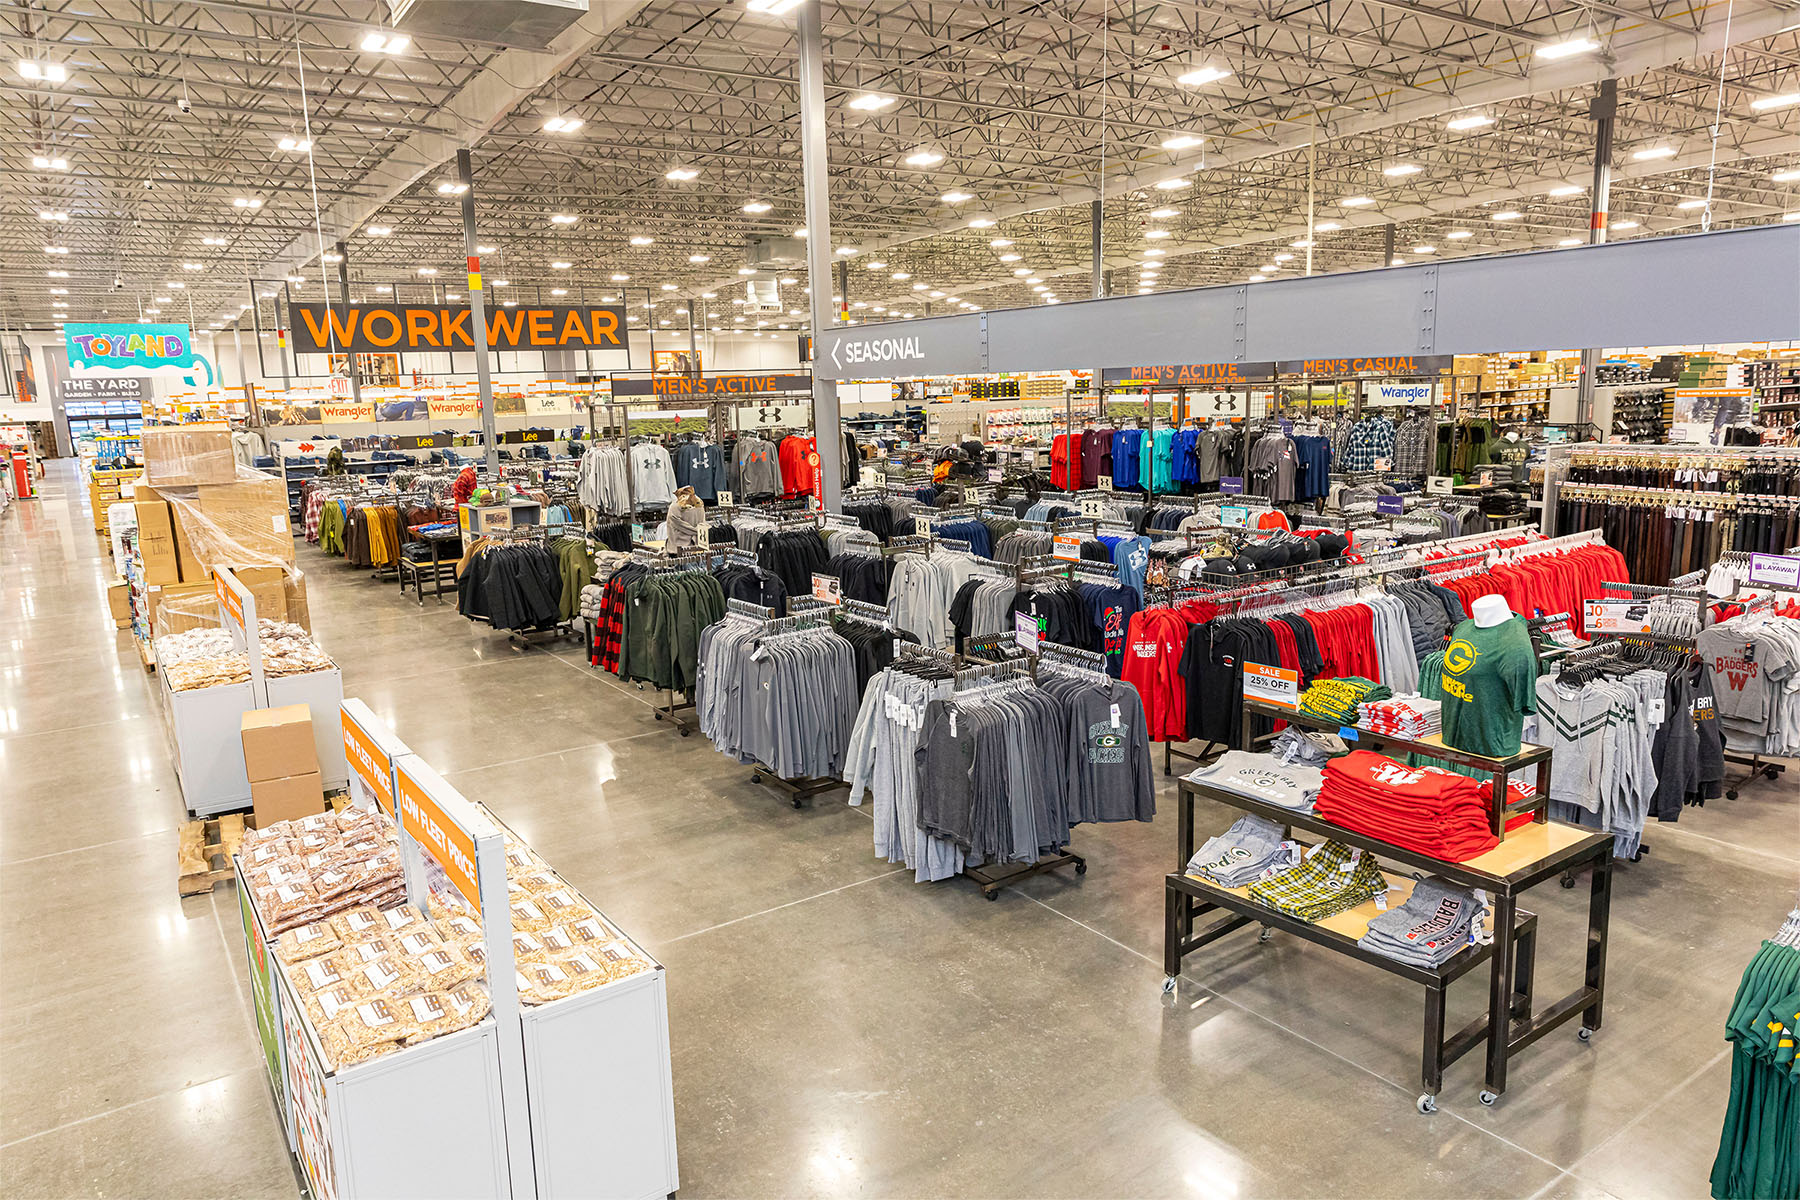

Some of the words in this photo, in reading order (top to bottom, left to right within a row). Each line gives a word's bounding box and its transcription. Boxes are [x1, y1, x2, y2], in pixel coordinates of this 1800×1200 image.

[300, 308, 621, 348] WORKWEAR
[72, 334, 183, 358] TOYLAND
[845, 337, 925, 363] SEASONAL
[1131, 365, 1175, 379] MEN'S
[1179, 363, 1238, 378] ACTIVE
[1303, 359, 1349, 373] MEN'S
[1352, 356, 1418, 371] CASUAL
[62, 380, 93, 391] THE
[96, 379, 140, 390] YARD
[332, 379, 349, 394] EXIT
[652, 379, 708, 394] MEN'S
[713, 377, 776, 393] ACTIVE
[1380, 386, 1430, 403] Wrangler
[431, 403, 475, 416] Wrangler
[541, 399, 555, 407] Lee
[323, 405, 372, 420] Wrangler
[416, 437, 434, 447] Lee
[522, 432, 538, 442] Lee
[1763, 564, 1797, 573] LAYAWAY
[1259, 666, 1281, 677] SALE
[1716, 657, 1758, 679] BADGERS
[1250, 675, 1269, 687] 25%
[1270, 680, 1290, 690] OFF
[1727, 671, 1749, 691] W
[1697, 696, 1713, 709] BAY
[343, 727, 355, 752] LOW
[355, 741, 373, 772] FLEET
[373, 760, 392, 796] PRICE
[401, 788, 419, 824] LOW
[420, 807, 446, 853] FLEET
[447, 837, 477, 887] PRICE
